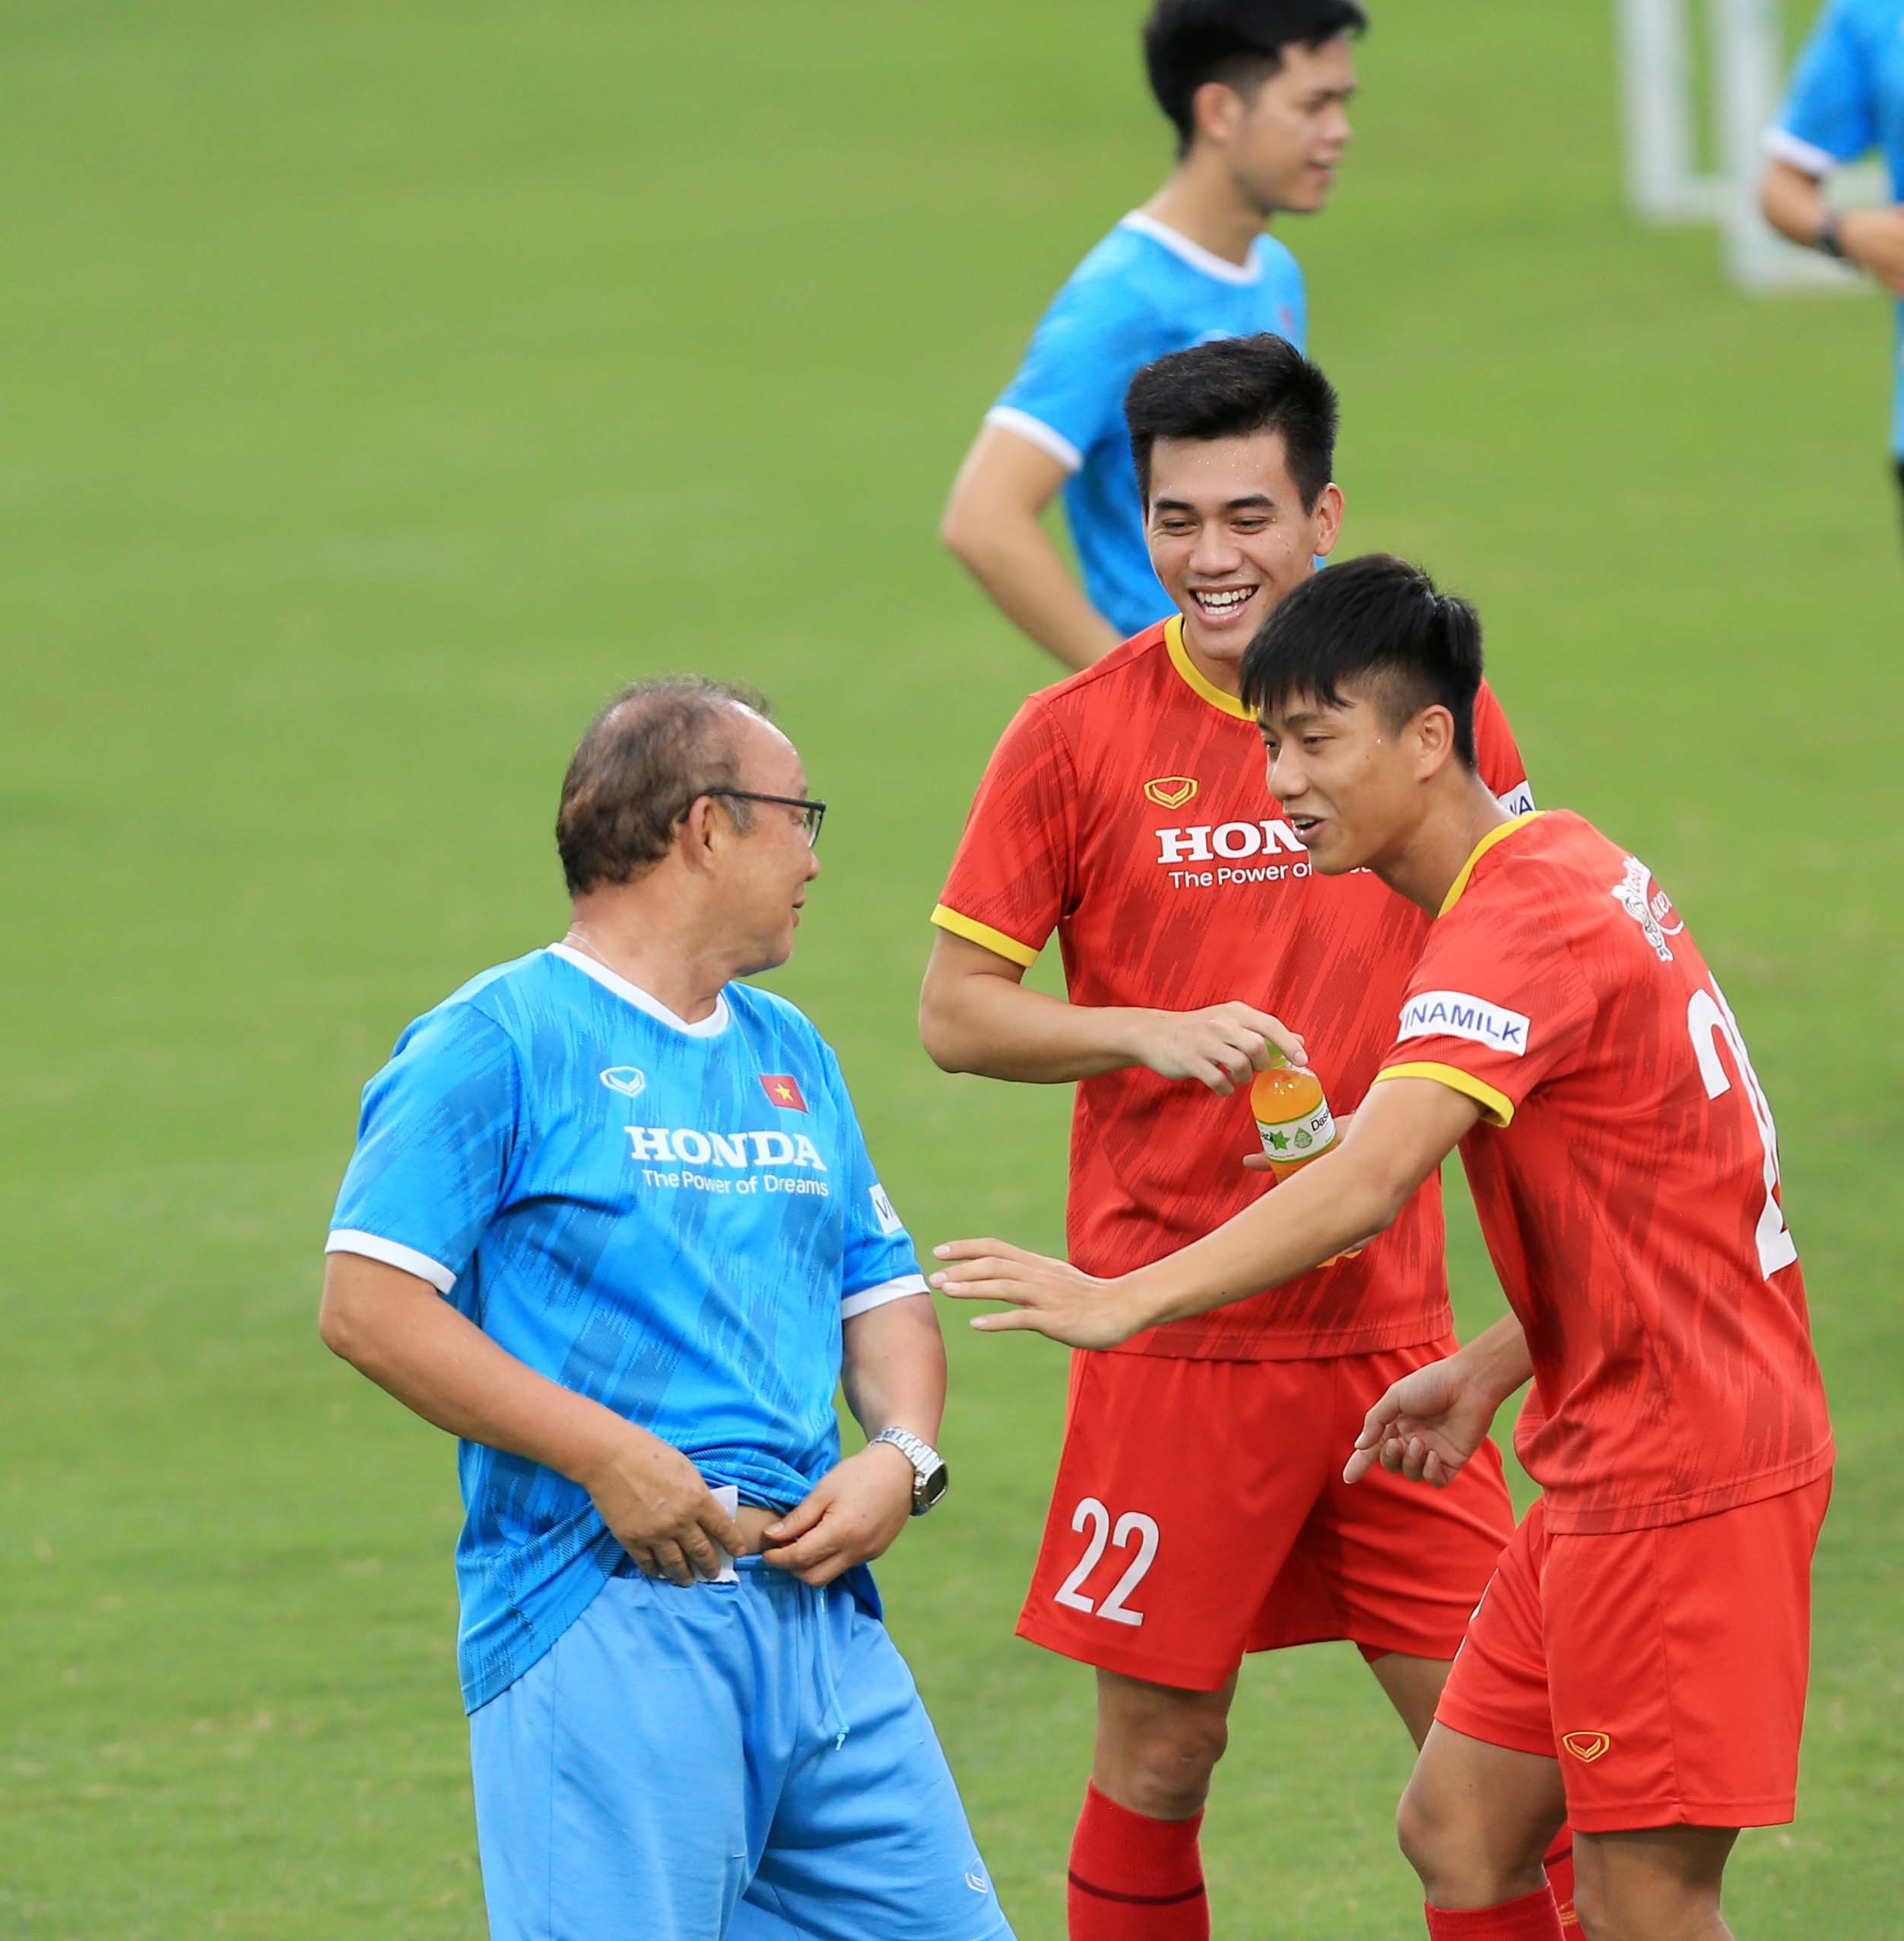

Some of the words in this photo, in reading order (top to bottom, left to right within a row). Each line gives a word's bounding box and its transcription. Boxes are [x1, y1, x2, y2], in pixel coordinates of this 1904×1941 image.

[1154, 818, 1308, 864] HON
[1169, 870, 1213, 889] The
[1217, 862, 1289, 886] Power
[1404, 1001, 1522, 1045] INAMILK
[624, 1126, 828, 1172] HONDA
[642, 1168, 680, 1188] The
[683, 1171, 731, 1194] Power
[736, 1176, 759, 1194] of
[764, 1174, 829, 1197] Dreams
[1053, 1496, 1160, 1628] 22
